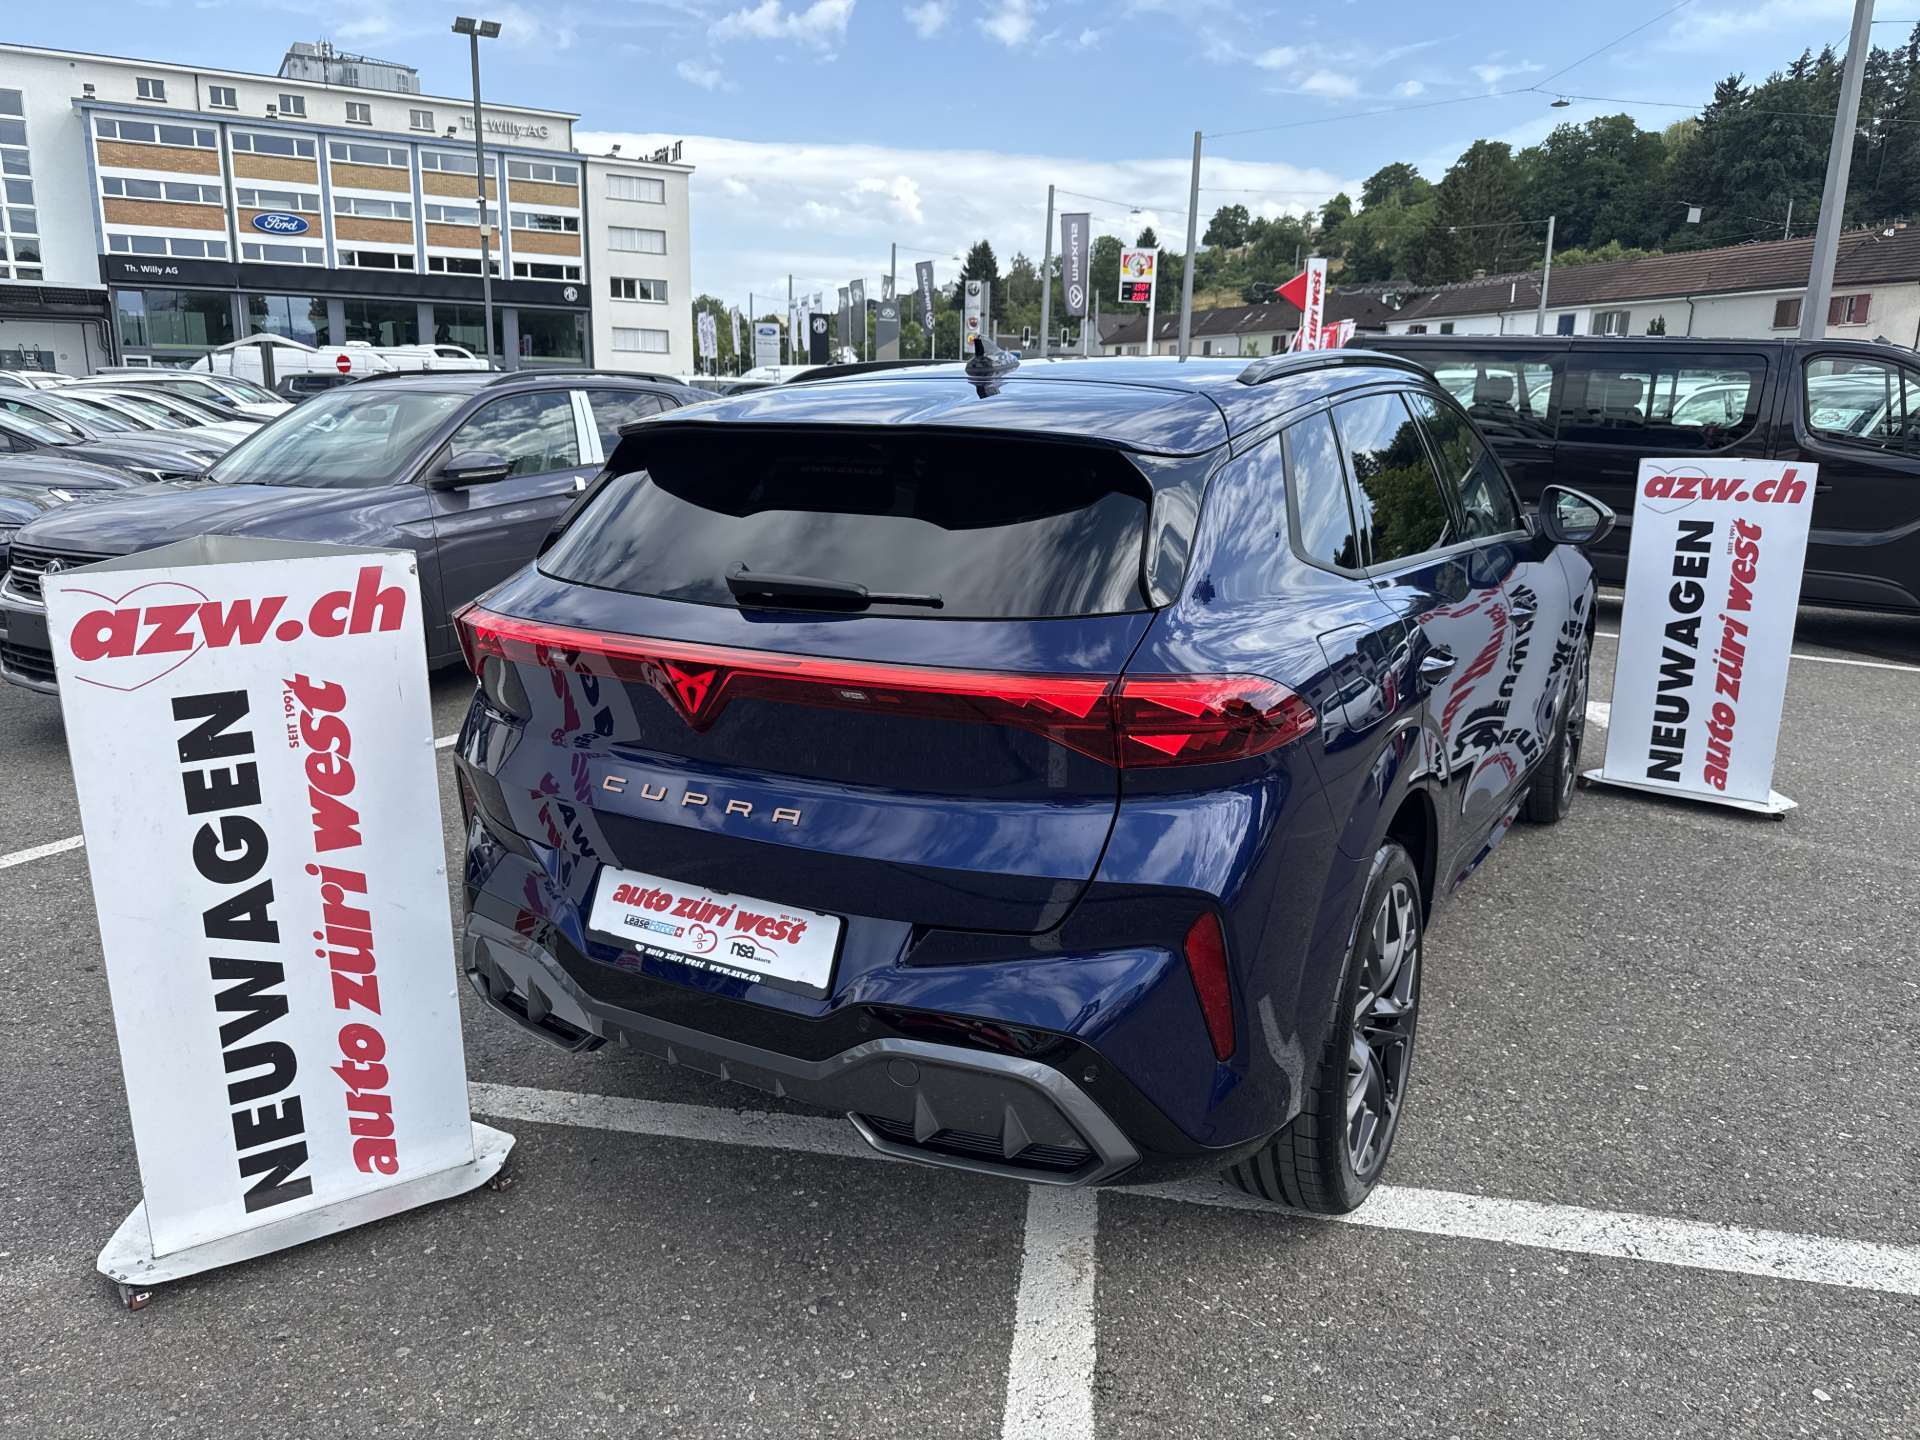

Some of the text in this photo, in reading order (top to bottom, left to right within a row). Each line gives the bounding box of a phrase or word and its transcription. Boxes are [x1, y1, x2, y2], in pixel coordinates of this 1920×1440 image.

[488, 119, 524, 139] Willy
[527, 125, 549, 139] AG
[264, 214, 298, 231] Ford
[125, 263, 179, 276] Th. Willy AG
[813, 317, 828, 334] MG
[1644, 469, 1808, 504] azw.ch
[70, 566, 407, 662] azw.ch
[1646, 520, 1715, 783] NEUWAGEN
[1704, 517, 1762, 791] auto züri west
[283, 689, 300, 749] SEIT 1991
[603, 775, 801, 826] CUPRA
[281, 673, 400, 1176] auto züri west
[612, 883, 808, 945] auto züri west
[171, 689, 314, 1214] NEUWAGEN
[684, 957, 706, 969] west
[730, 941, 756, 960] nsa
